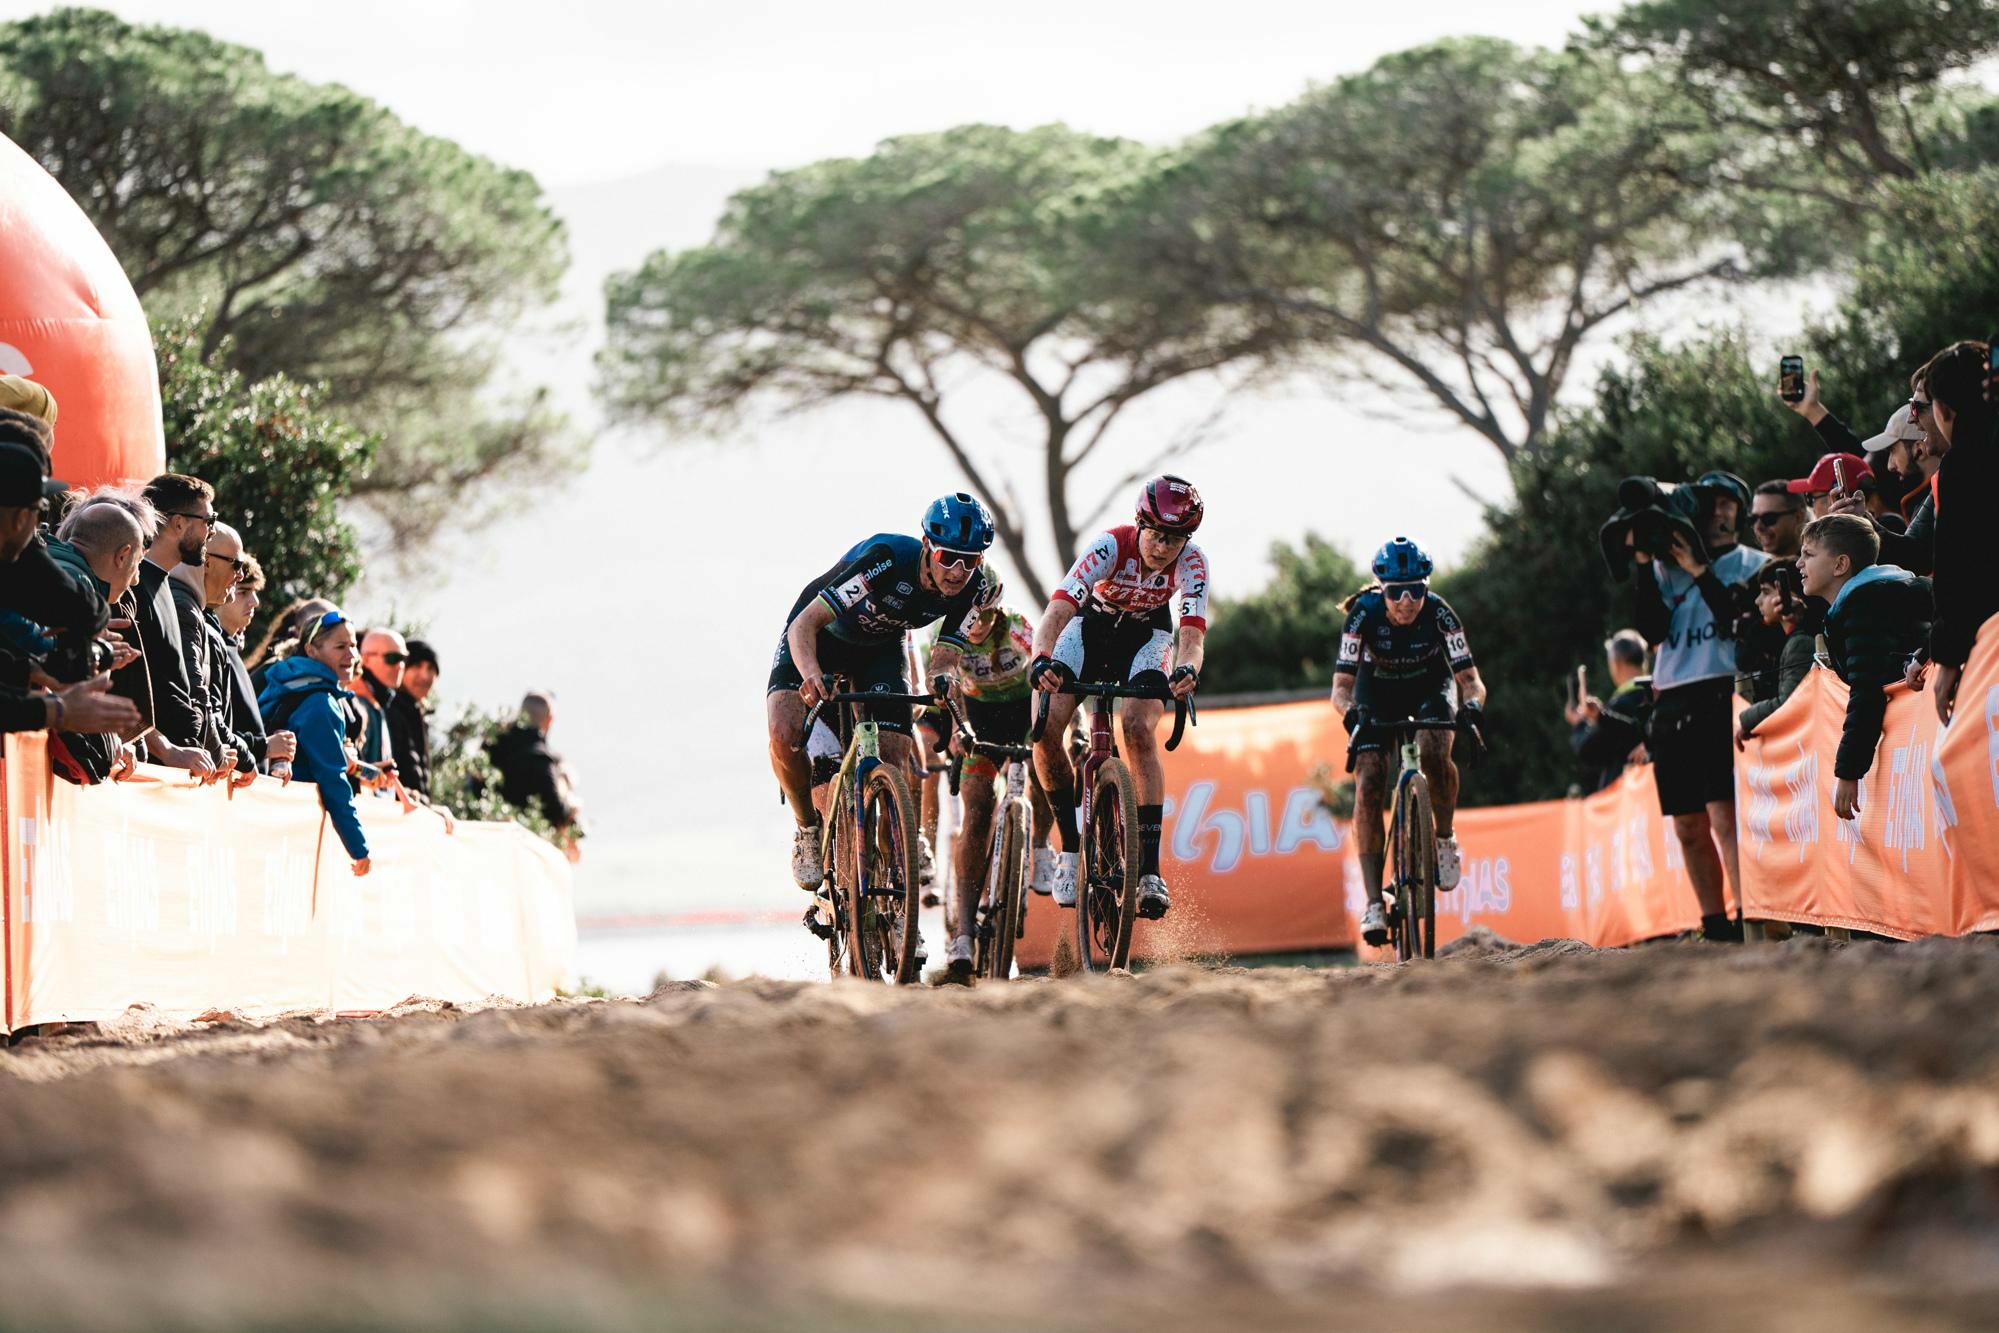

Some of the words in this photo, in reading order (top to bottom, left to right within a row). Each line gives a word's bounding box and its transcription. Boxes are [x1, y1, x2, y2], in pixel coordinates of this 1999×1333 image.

[864, 558, 893, 582] aloise
[844, 585, 861, 600] 2
[1073, 588, 1085, 601] 5
[1181, 602, 1191, 616] 5
[1350, 609, 1367, 634] aloise
[1450, 639, 1465, 653] 10
[1667, 631, 1681, 650] V
[1343, 641, 1358, 656] 10
